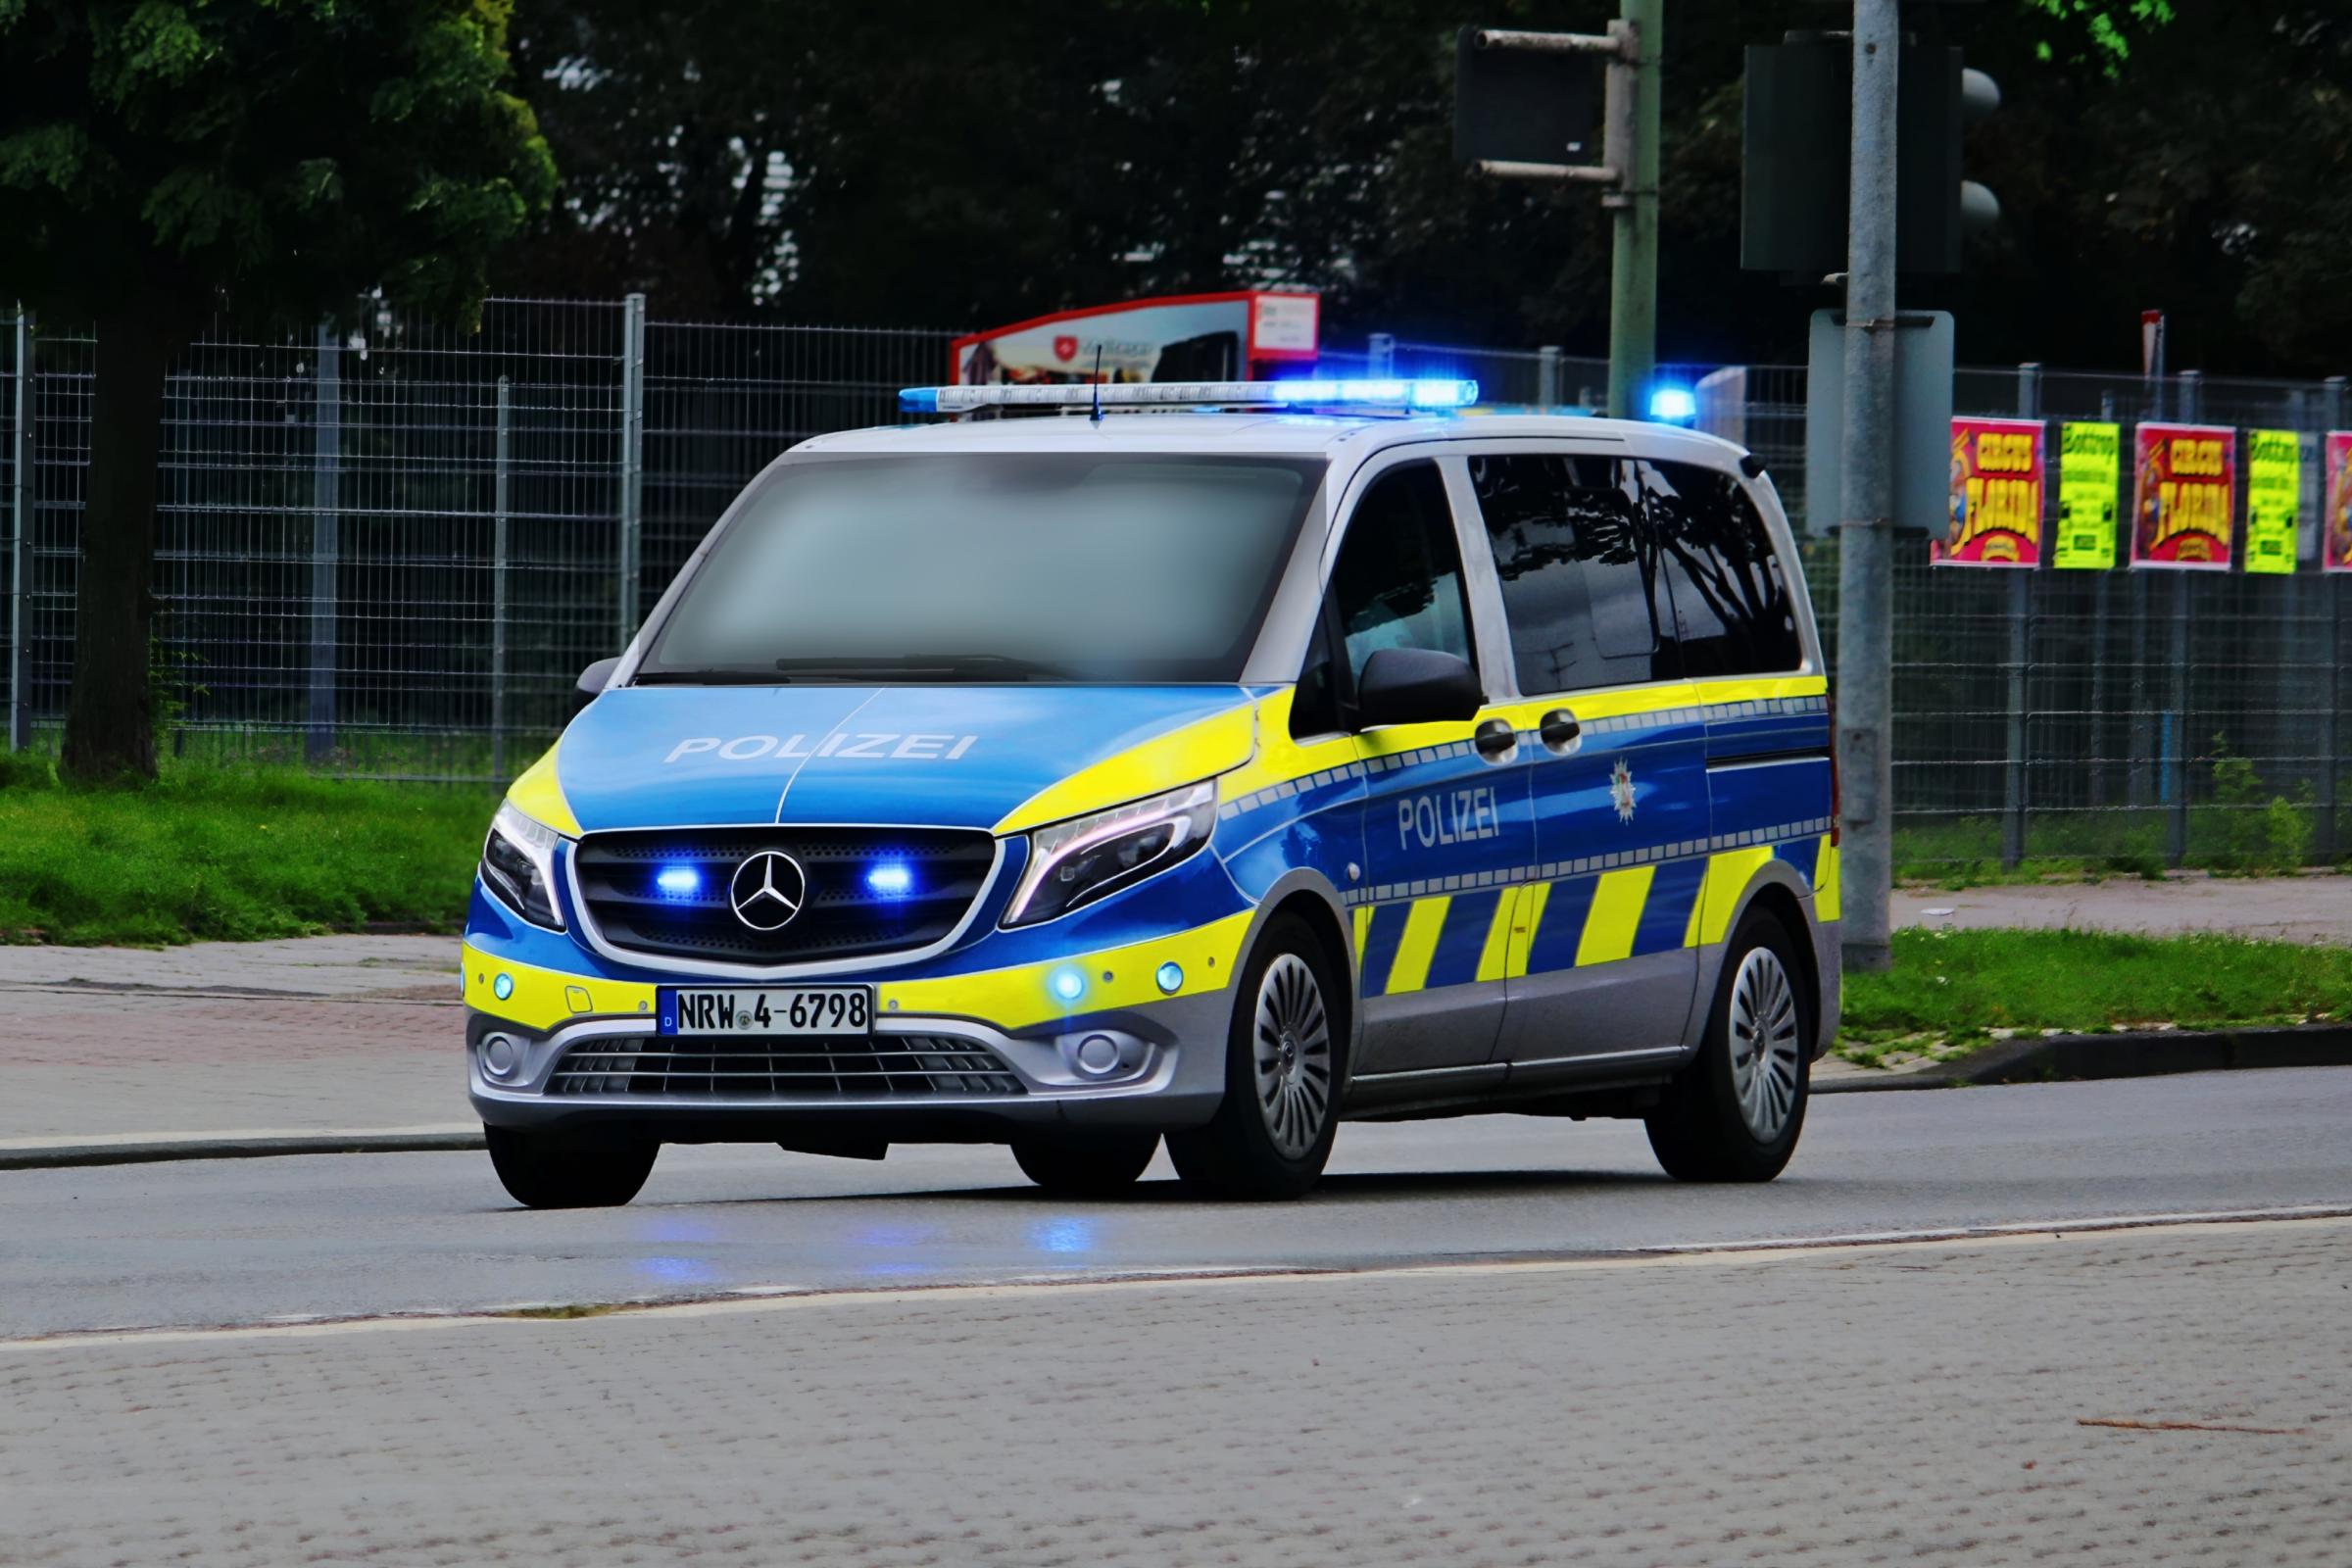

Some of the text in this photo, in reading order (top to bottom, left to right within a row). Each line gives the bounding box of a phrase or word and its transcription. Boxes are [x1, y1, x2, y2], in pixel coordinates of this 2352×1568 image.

[663, 733, 979, 763] POLIZEI
[1398, 786, 1499, 851] POLIZEI
[663, 1016, 672, 1027] D
[677, 993, 866, 1029] NRW 4-6798
